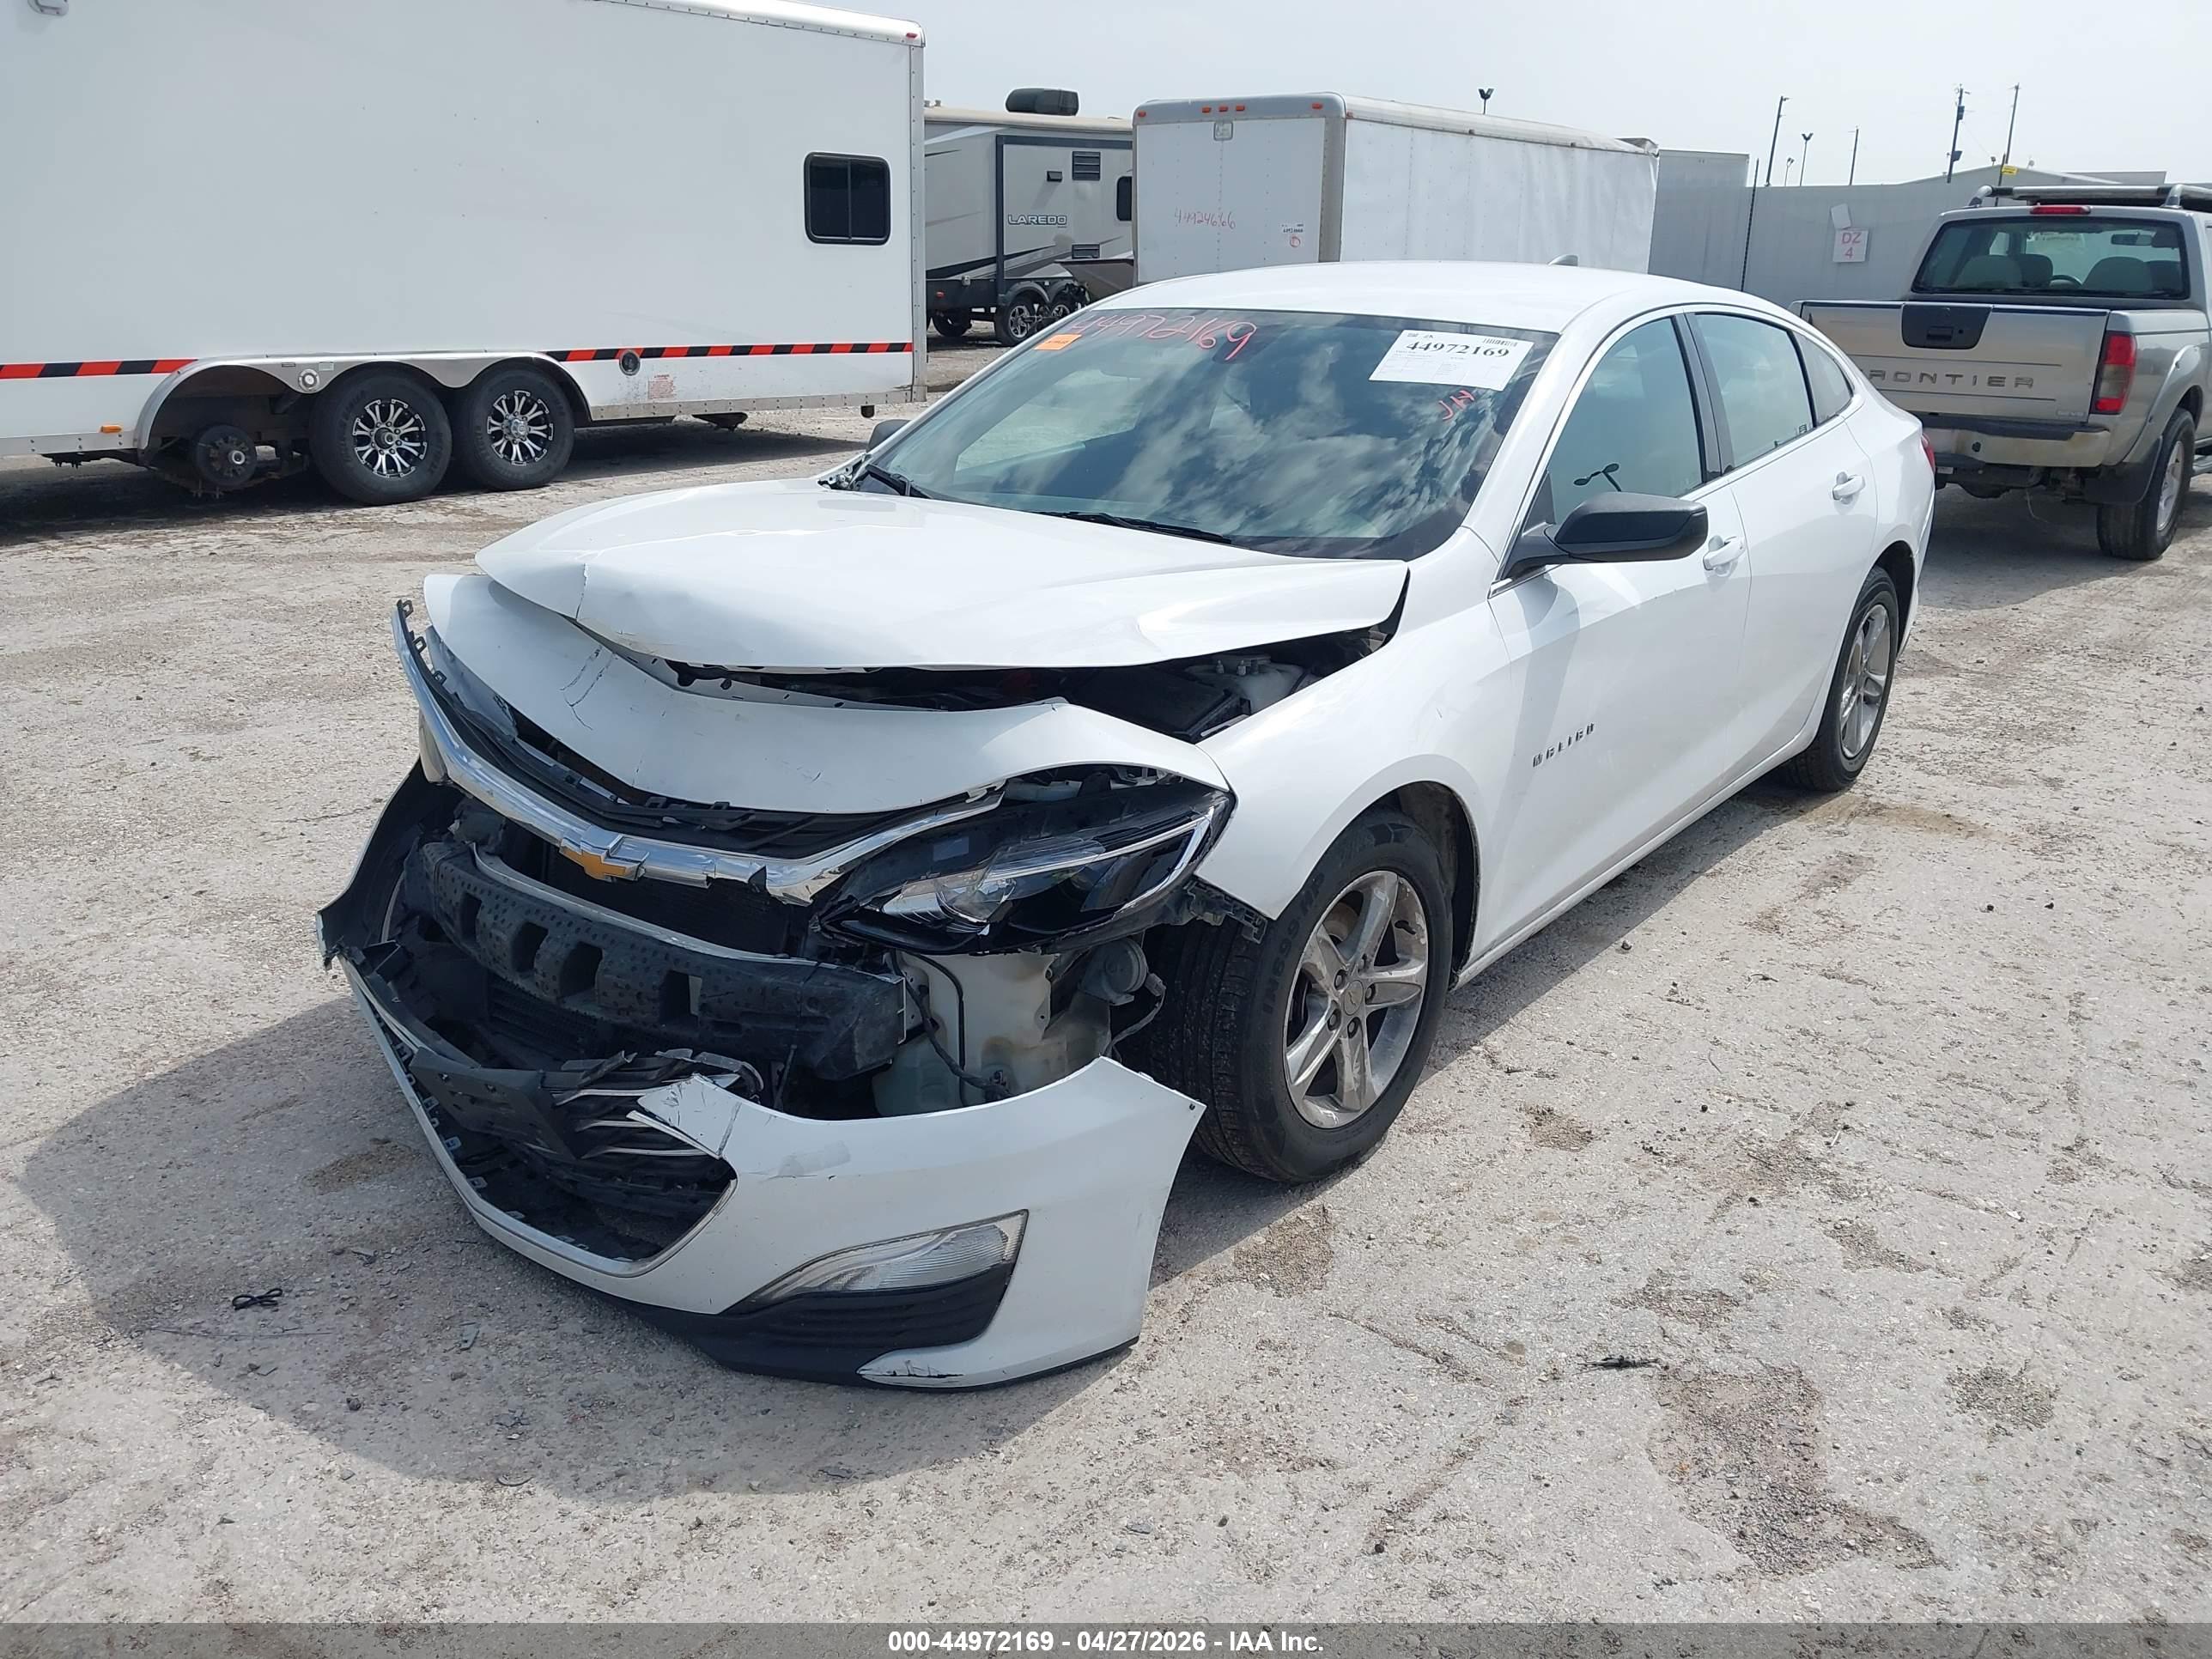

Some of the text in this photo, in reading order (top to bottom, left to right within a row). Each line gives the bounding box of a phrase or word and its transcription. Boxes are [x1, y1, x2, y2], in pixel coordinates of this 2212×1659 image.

[1007, 214, 1067, 226] LAREDO
[1841, 232, 1863, 245] DZ
[1844, 246, 1855, 260] 4
[1073, 314, 1258, 362] 44972169
[1406, 341, 1510, 358] 44972169
[1860, 368, 2034, 390] RONTIER
